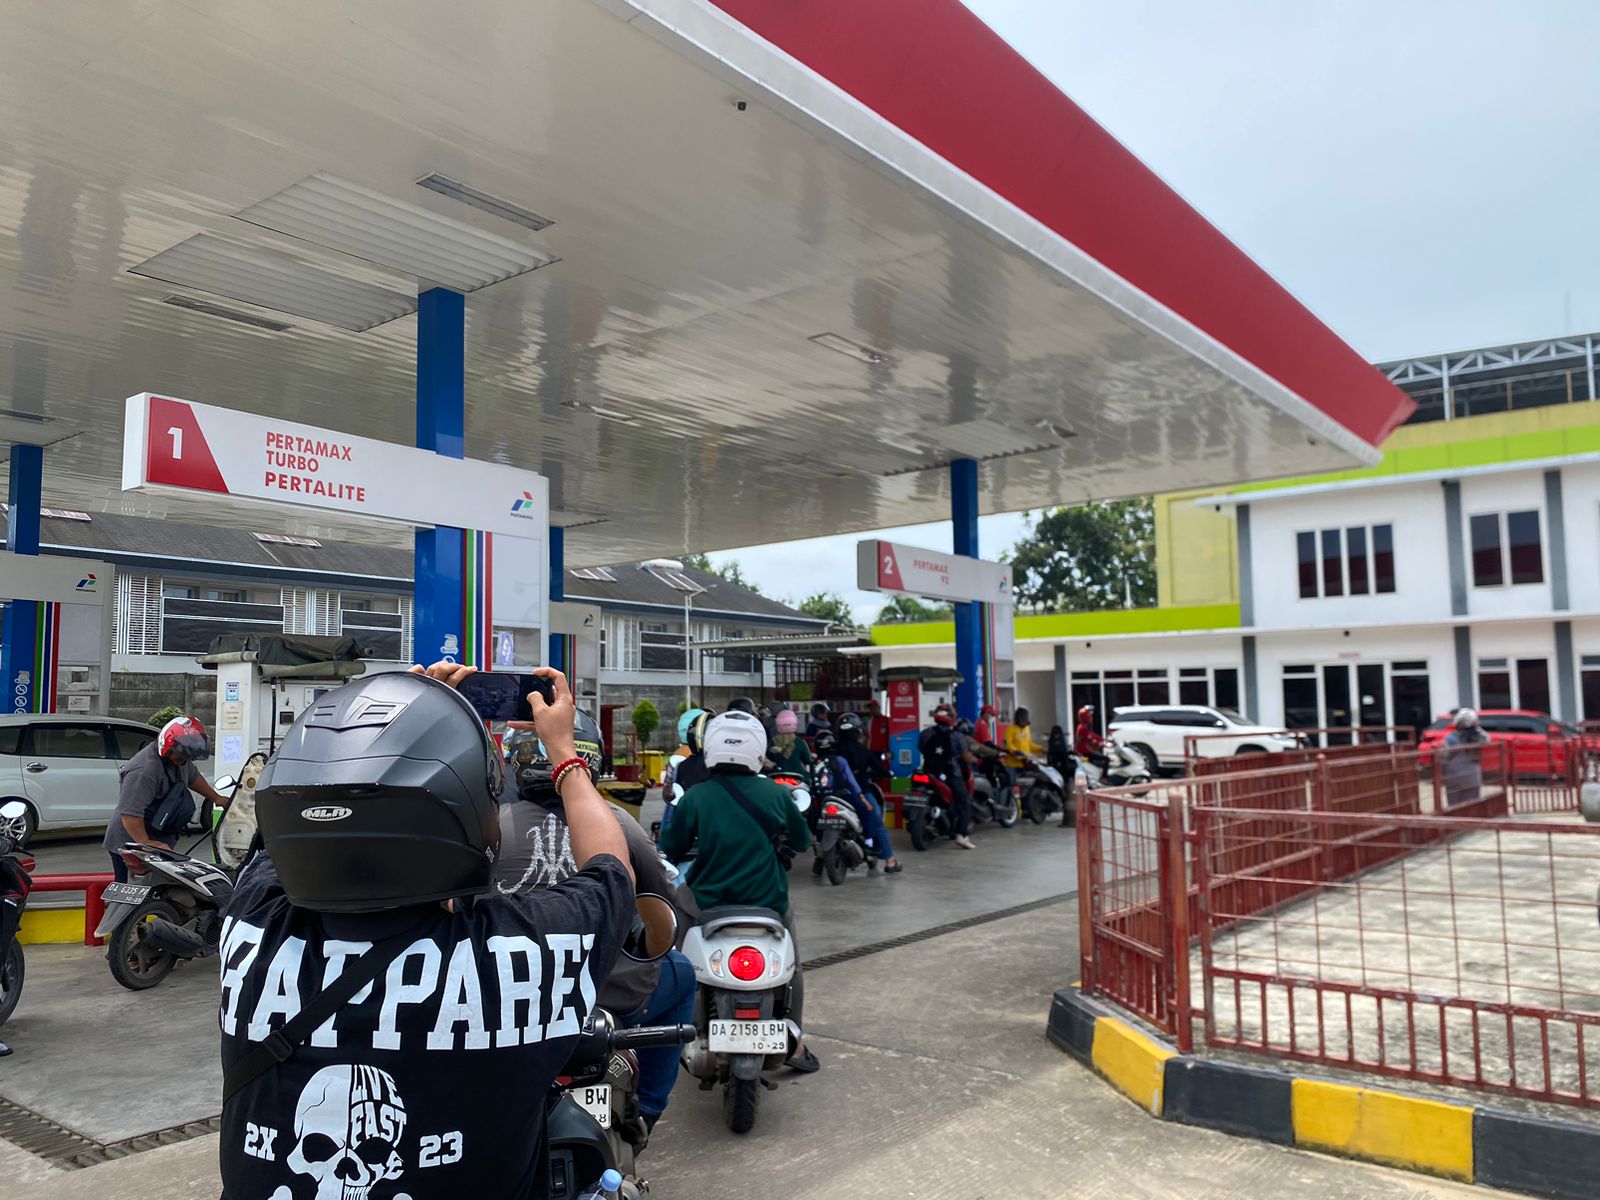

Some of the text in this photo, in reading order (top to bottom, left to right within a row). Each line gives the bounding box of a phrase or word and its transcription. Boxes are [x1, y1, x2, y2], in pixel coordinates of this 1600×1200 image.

[167, 427, 183, 460] 1
[266, 431, 352, 461] PERTAMAX
[266, 450, 319, 473] TURBO
[264, 471, 366, 502] PERTALITE
[883, 556, 893, 575] 2
[711, 1023, 785, 1037] DA 2158 LBM
[351, 1064, 405, 1109] LIVE
[244, 1121, 278, 1161] 2X
[351, 1101, 407, 1150] FAST
[419, 1130, 463, 1168] 23
